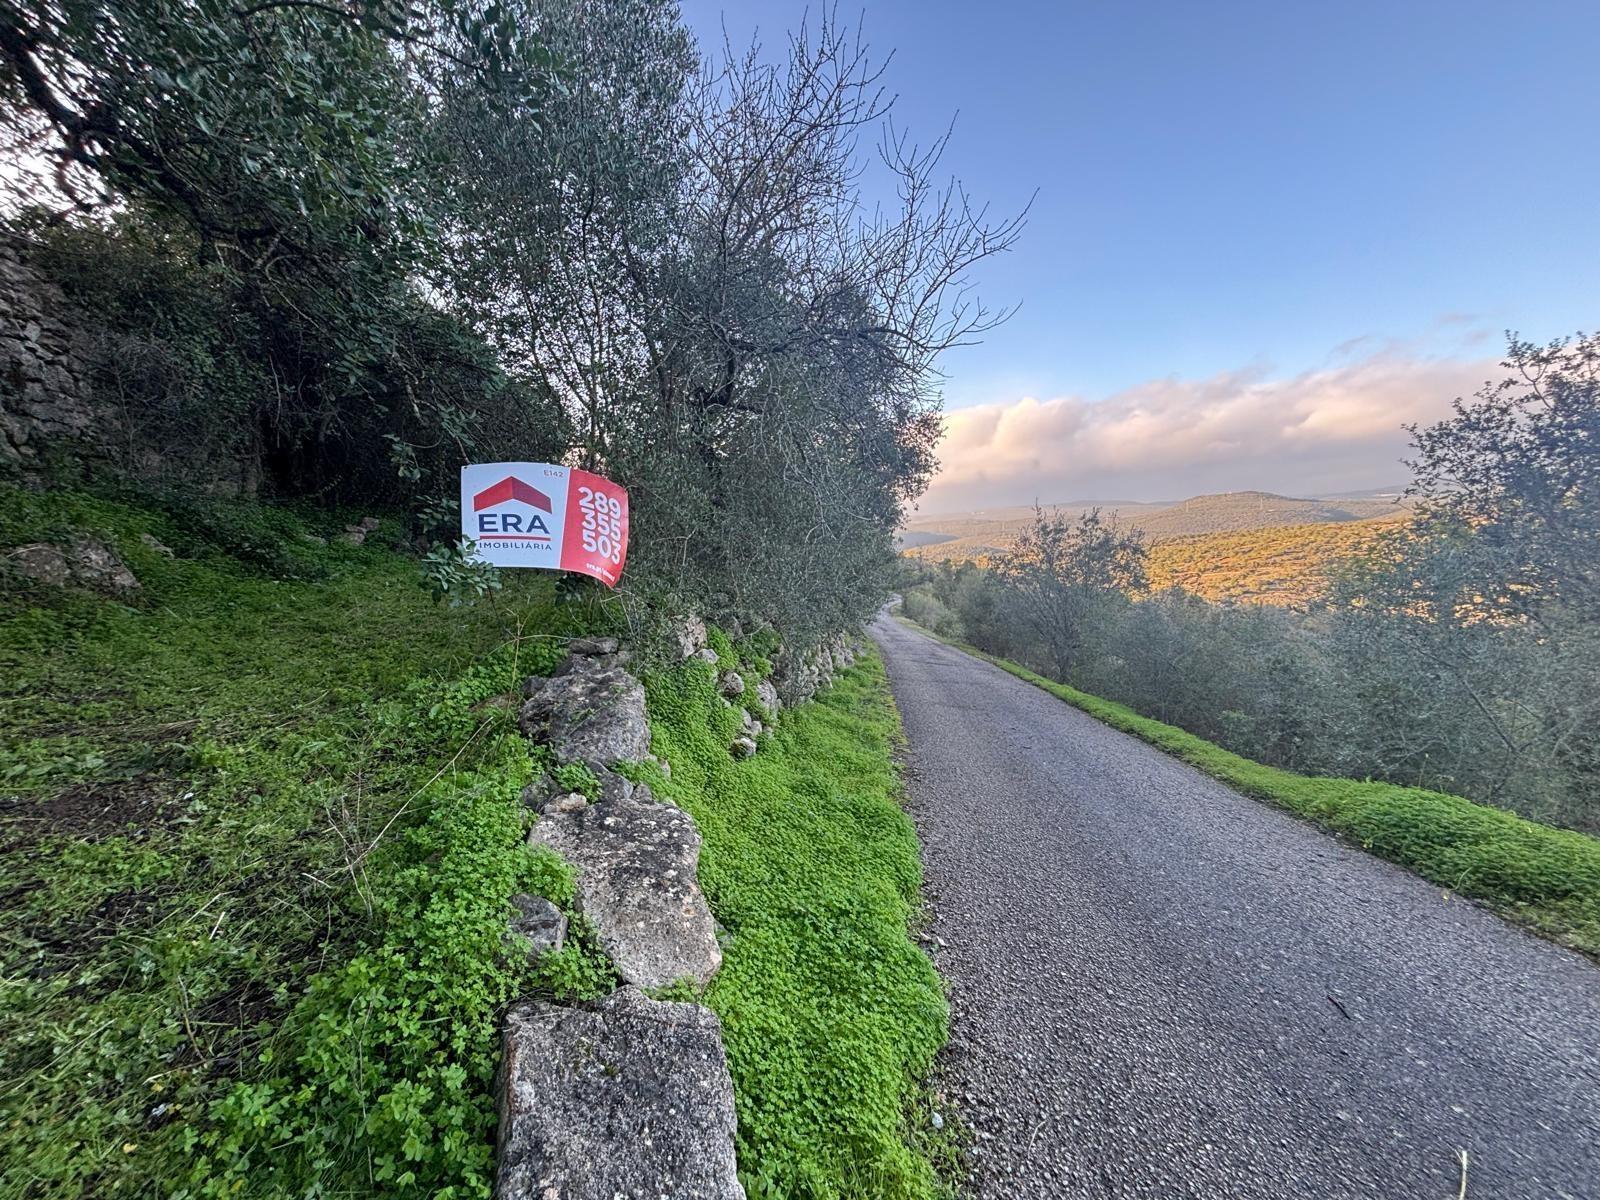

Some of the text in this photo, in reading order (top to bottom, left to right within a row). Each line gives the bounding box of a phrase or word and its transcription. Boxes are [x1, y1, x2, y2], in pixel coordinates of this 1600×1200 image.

[544, 469, 564, 478] E142
[578, 486, 621, 520] 289
[478, 513, 550, 535] ERA
[581, 507, 621, 542] 355
[479, 541, 552, 551] IMOBILIÁRIA
[582, 529, 621, 564] 503
